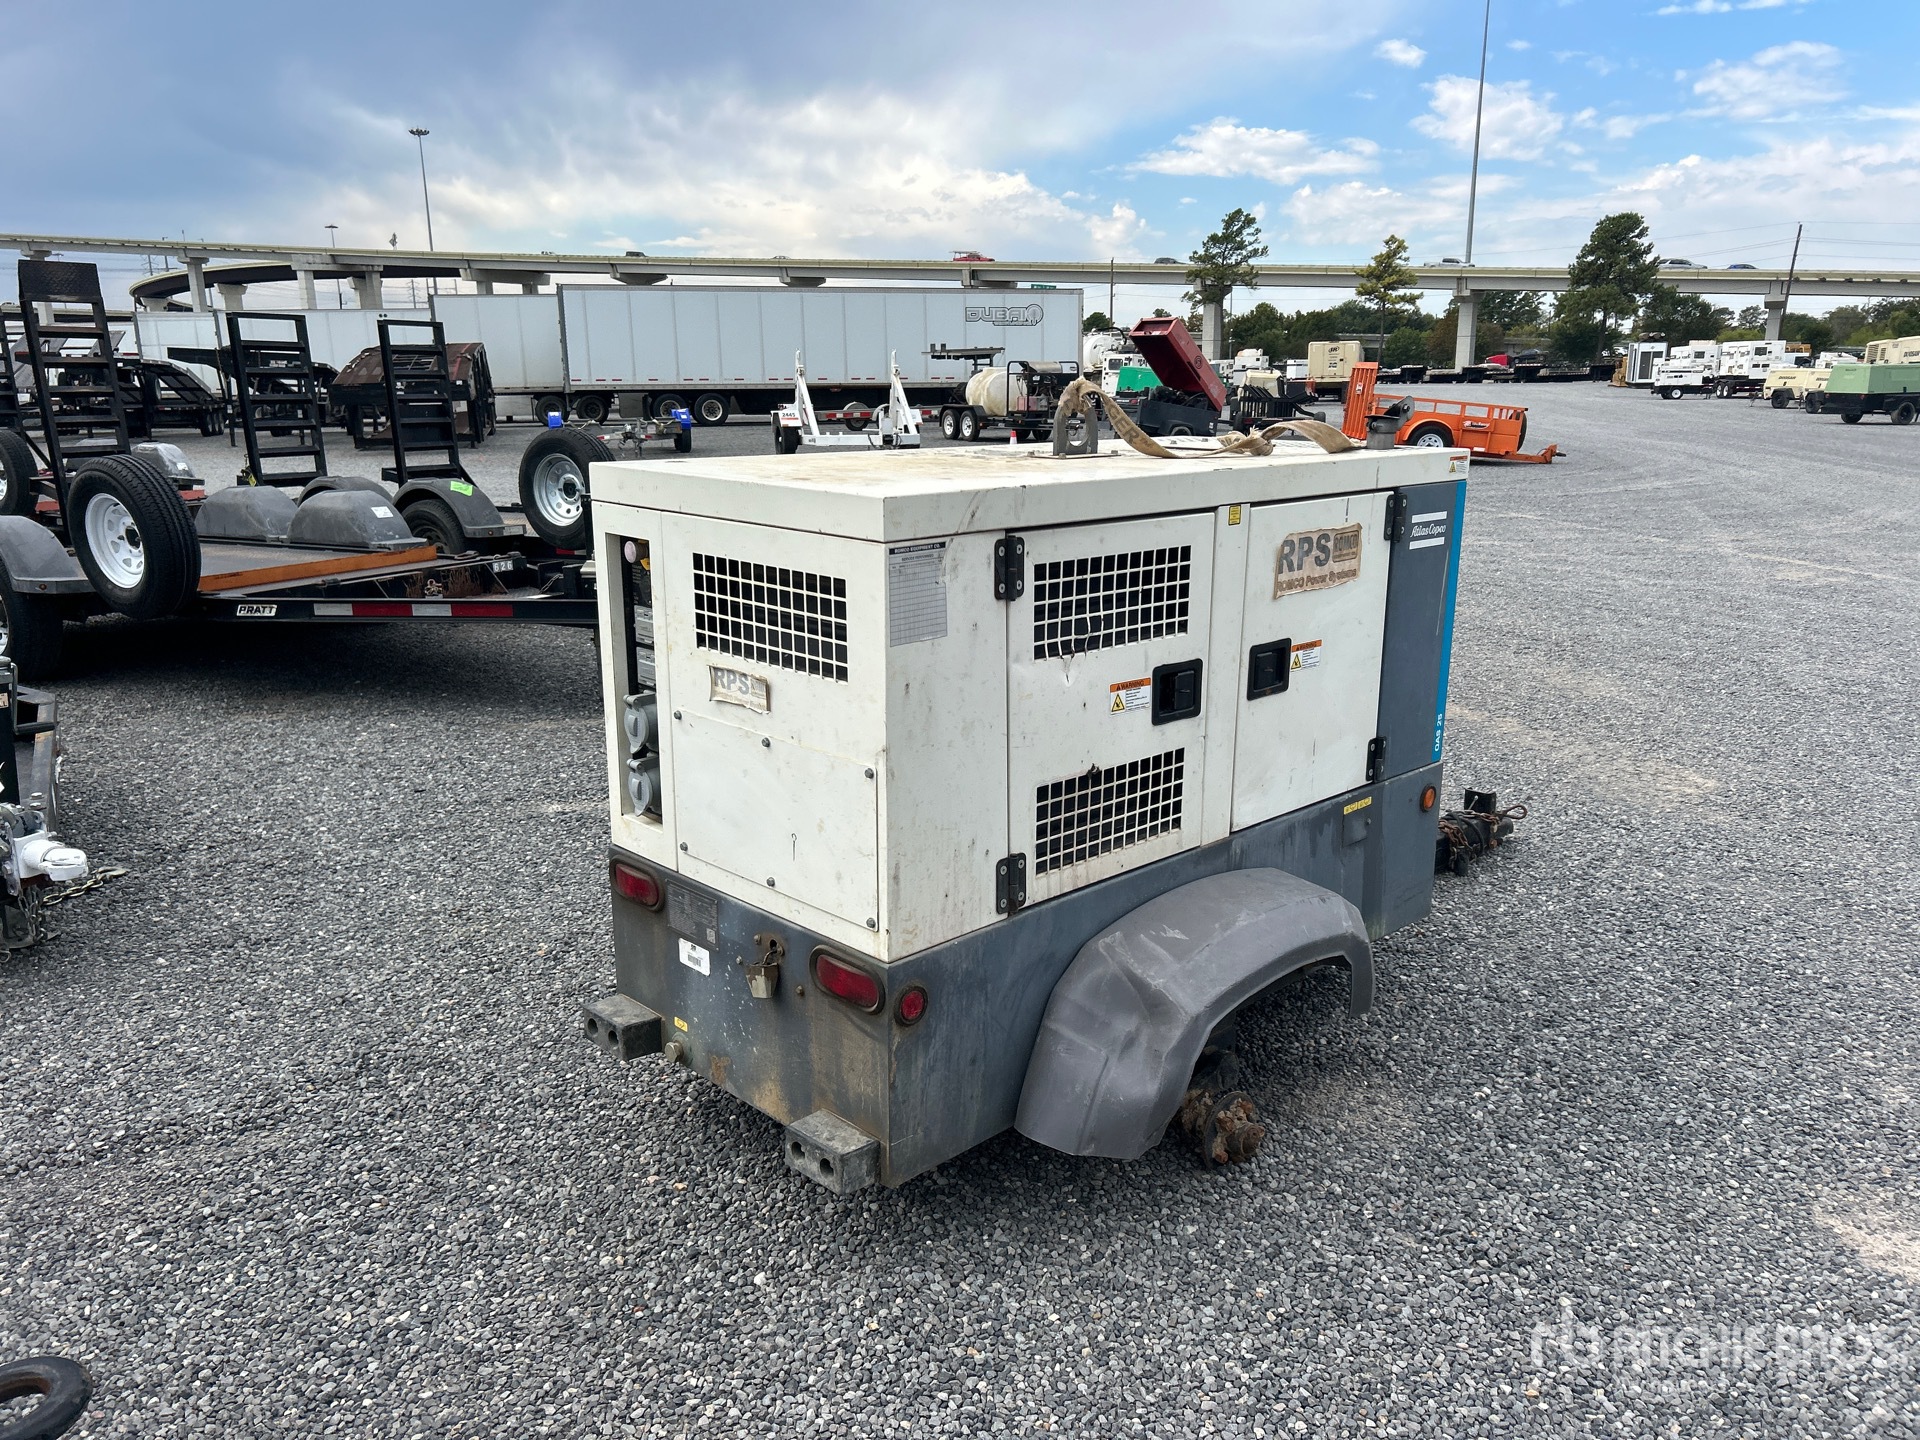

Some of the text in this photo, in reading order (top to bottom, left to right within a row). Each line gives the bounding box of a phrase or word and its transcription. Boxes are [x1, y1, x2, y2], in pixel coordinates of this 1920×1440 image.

[1410, 523, 1447, 538] Atlas Copco
[1278, 533, 1331, 575] RPS
[1306, 573, 1328, 587] Power
[1328, 568, 1357, 584] Systems
[239, 604, 276, 616] PRATT
[714, 667, 750, 696] RPS
[1120, 680, 1145, 690] WARNING
[1436, 713, 1443, 727] 25
